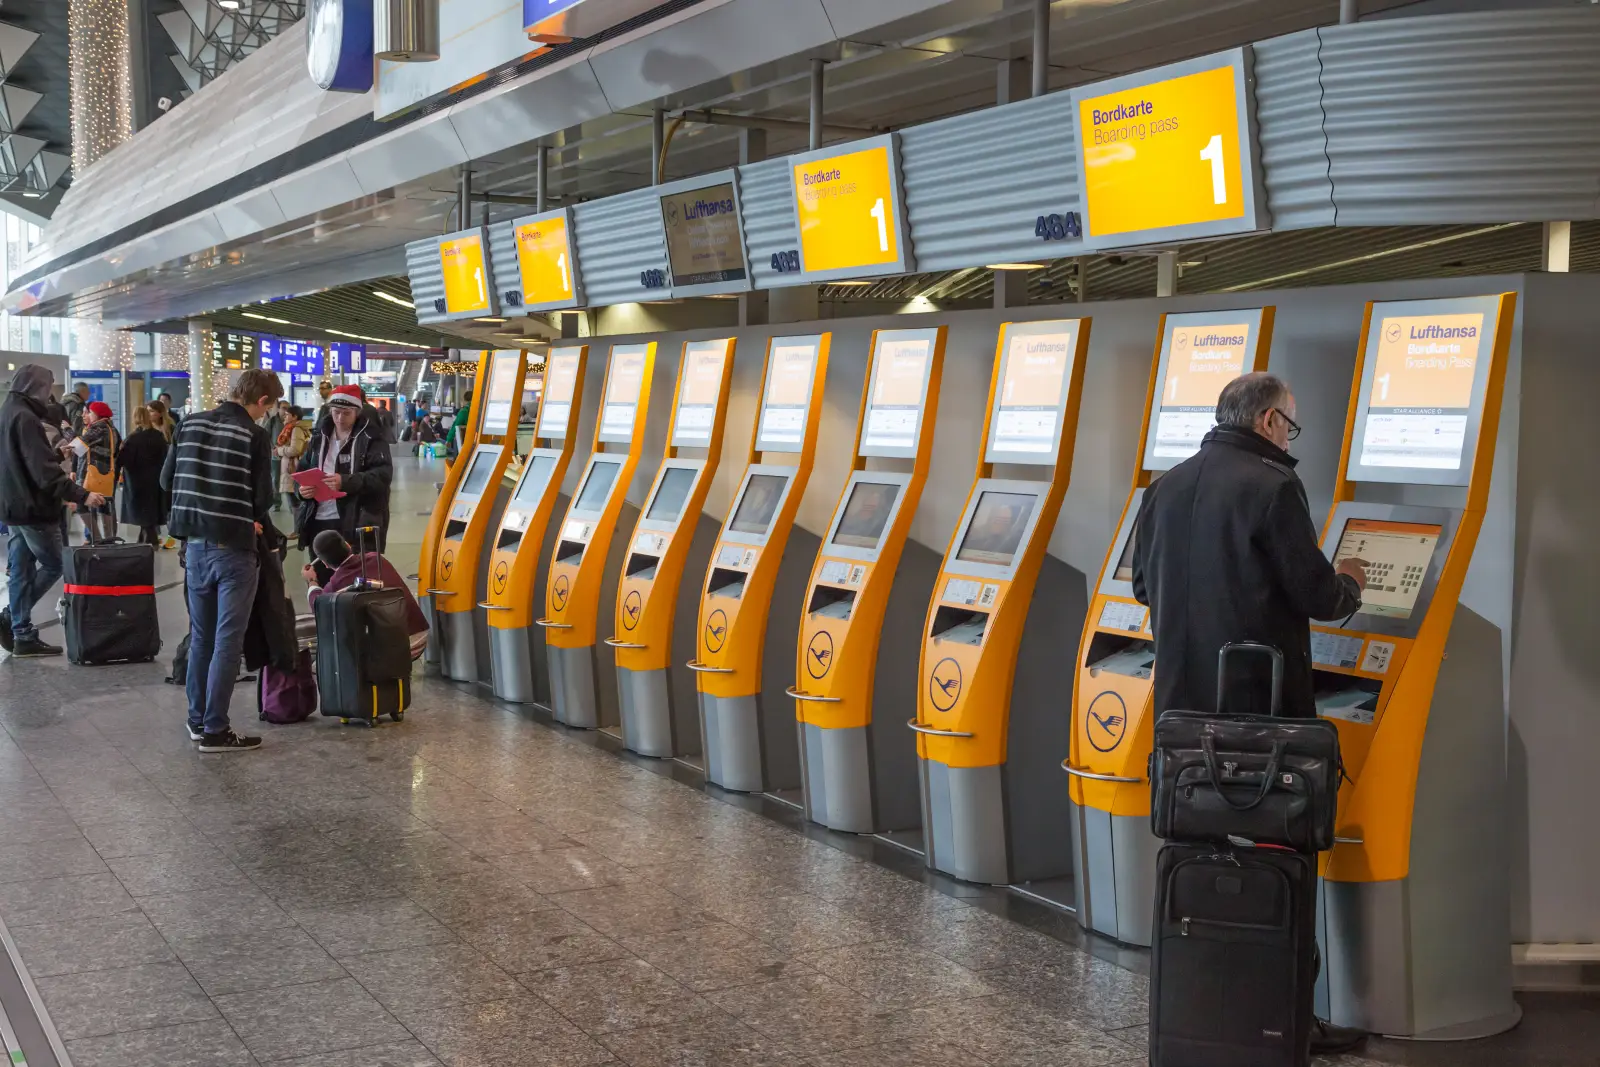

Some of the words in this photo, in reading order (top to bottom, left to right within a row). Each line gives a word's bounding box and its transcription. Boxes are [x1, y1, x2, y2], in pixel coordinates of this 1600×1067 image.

[1092, 99, 1153, 125] Bordkarte
[1093, 119, 1146, 145] Boarding
[1149, 115, 1179, 138] pass
[803, 168, 840, 186] Bordkarte
[1199, 134, 1227, 205] 1
[683, 198, 733, 221] Lufthansa
[870, 197, 889, 252] 1
[1034, 211, 1080, 241] 46A
[474, 267, 485, 302] 1
[557, 252, 569, 292] 1
[1193, 334, 1244, 347] Lufthansa
[1409, 325, 1477, 340] Lufthansa
[1026, 341, 1067, 354] Lufthansa
[1407, 343, 1461, 355] Bordkarte
[1405, 356, 1447, 370] Boarding
[1449, 355, 1474, 369] Pass
[1169, 376, 1179, 401] 1
[1377, 372, 1391, 401] 1
